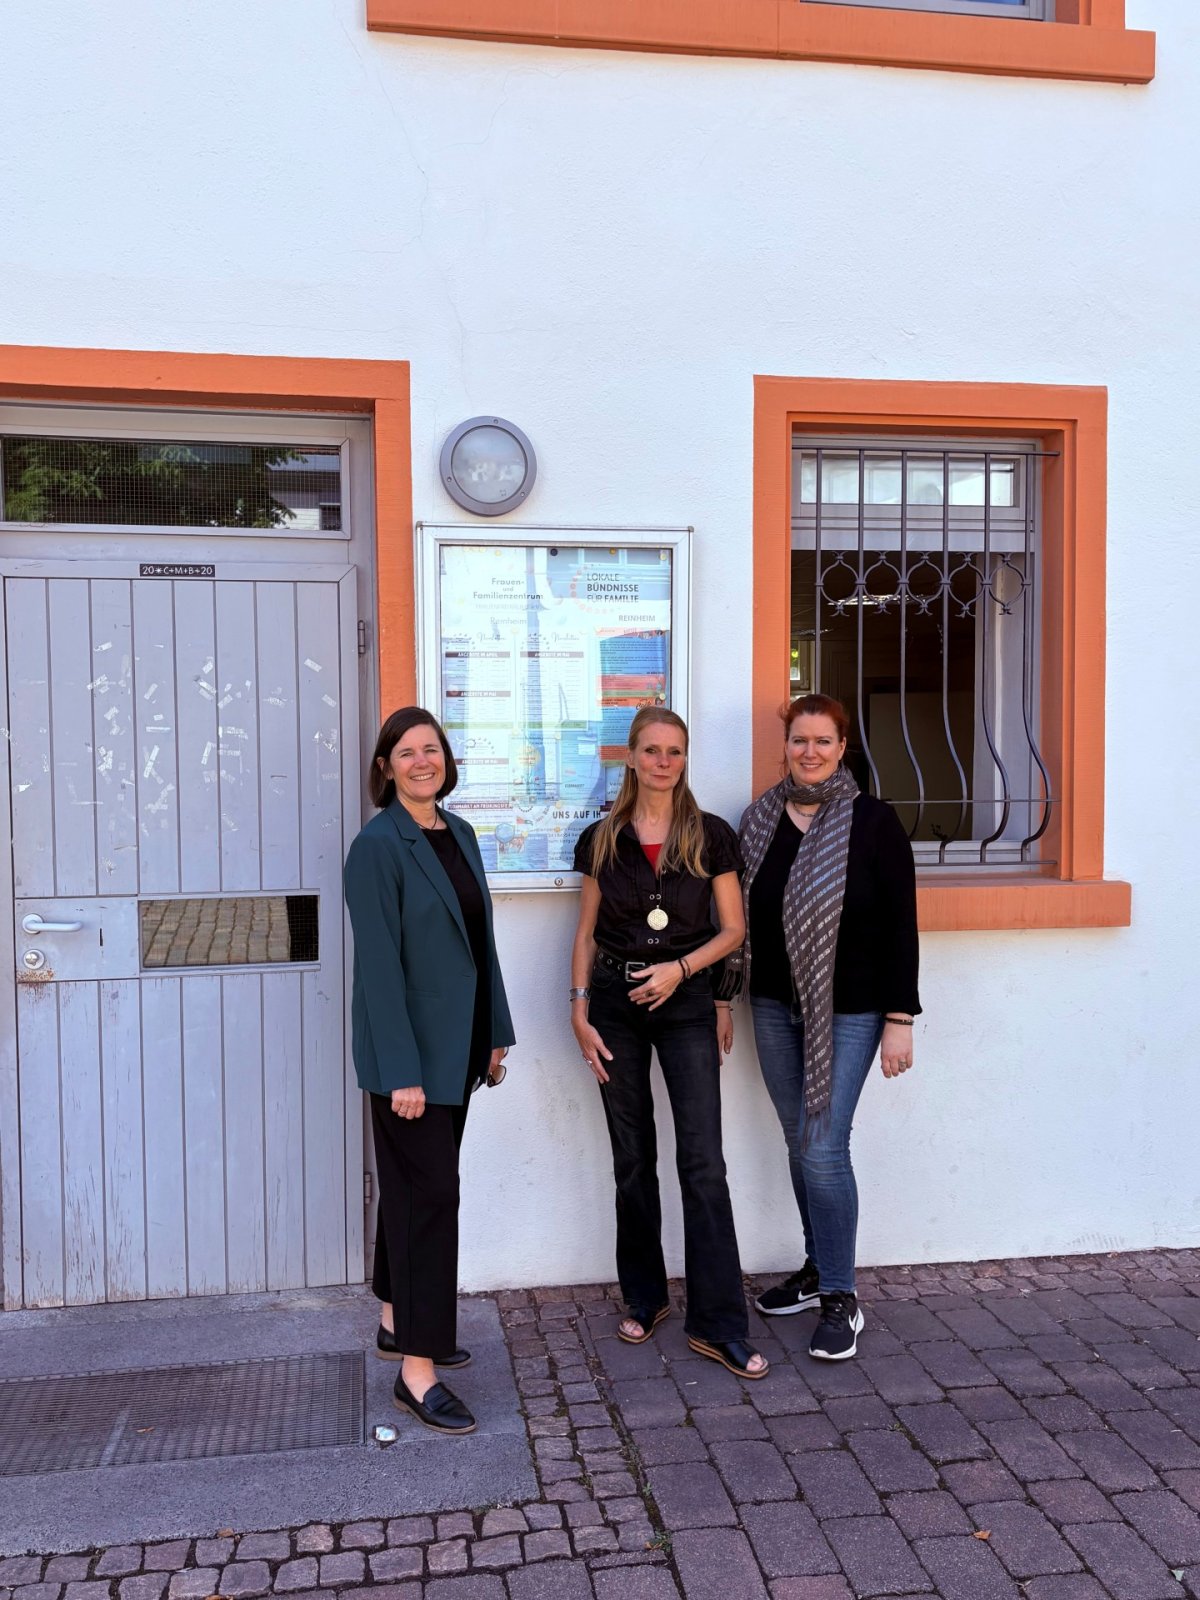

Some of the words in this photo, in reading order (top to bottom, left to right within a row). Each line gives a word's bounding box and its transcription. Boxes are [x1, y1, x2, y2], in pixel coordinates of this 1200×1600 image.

[491, 577, 525, 585] Frauen-
[586, 573, 620, 582] LOKALE
[586, 581, 640, 592] BÜNDNISSE
[473, 591, 544, 600] Familienzentrum
[586, 593, 603, 603] FÜR
[604, 594, 639, 603] FAMILIE
[618, 614, 656, 622] REINHEIM
[552, 810, 570, 819] UNS
[573, 810, 590, 819] AUF
